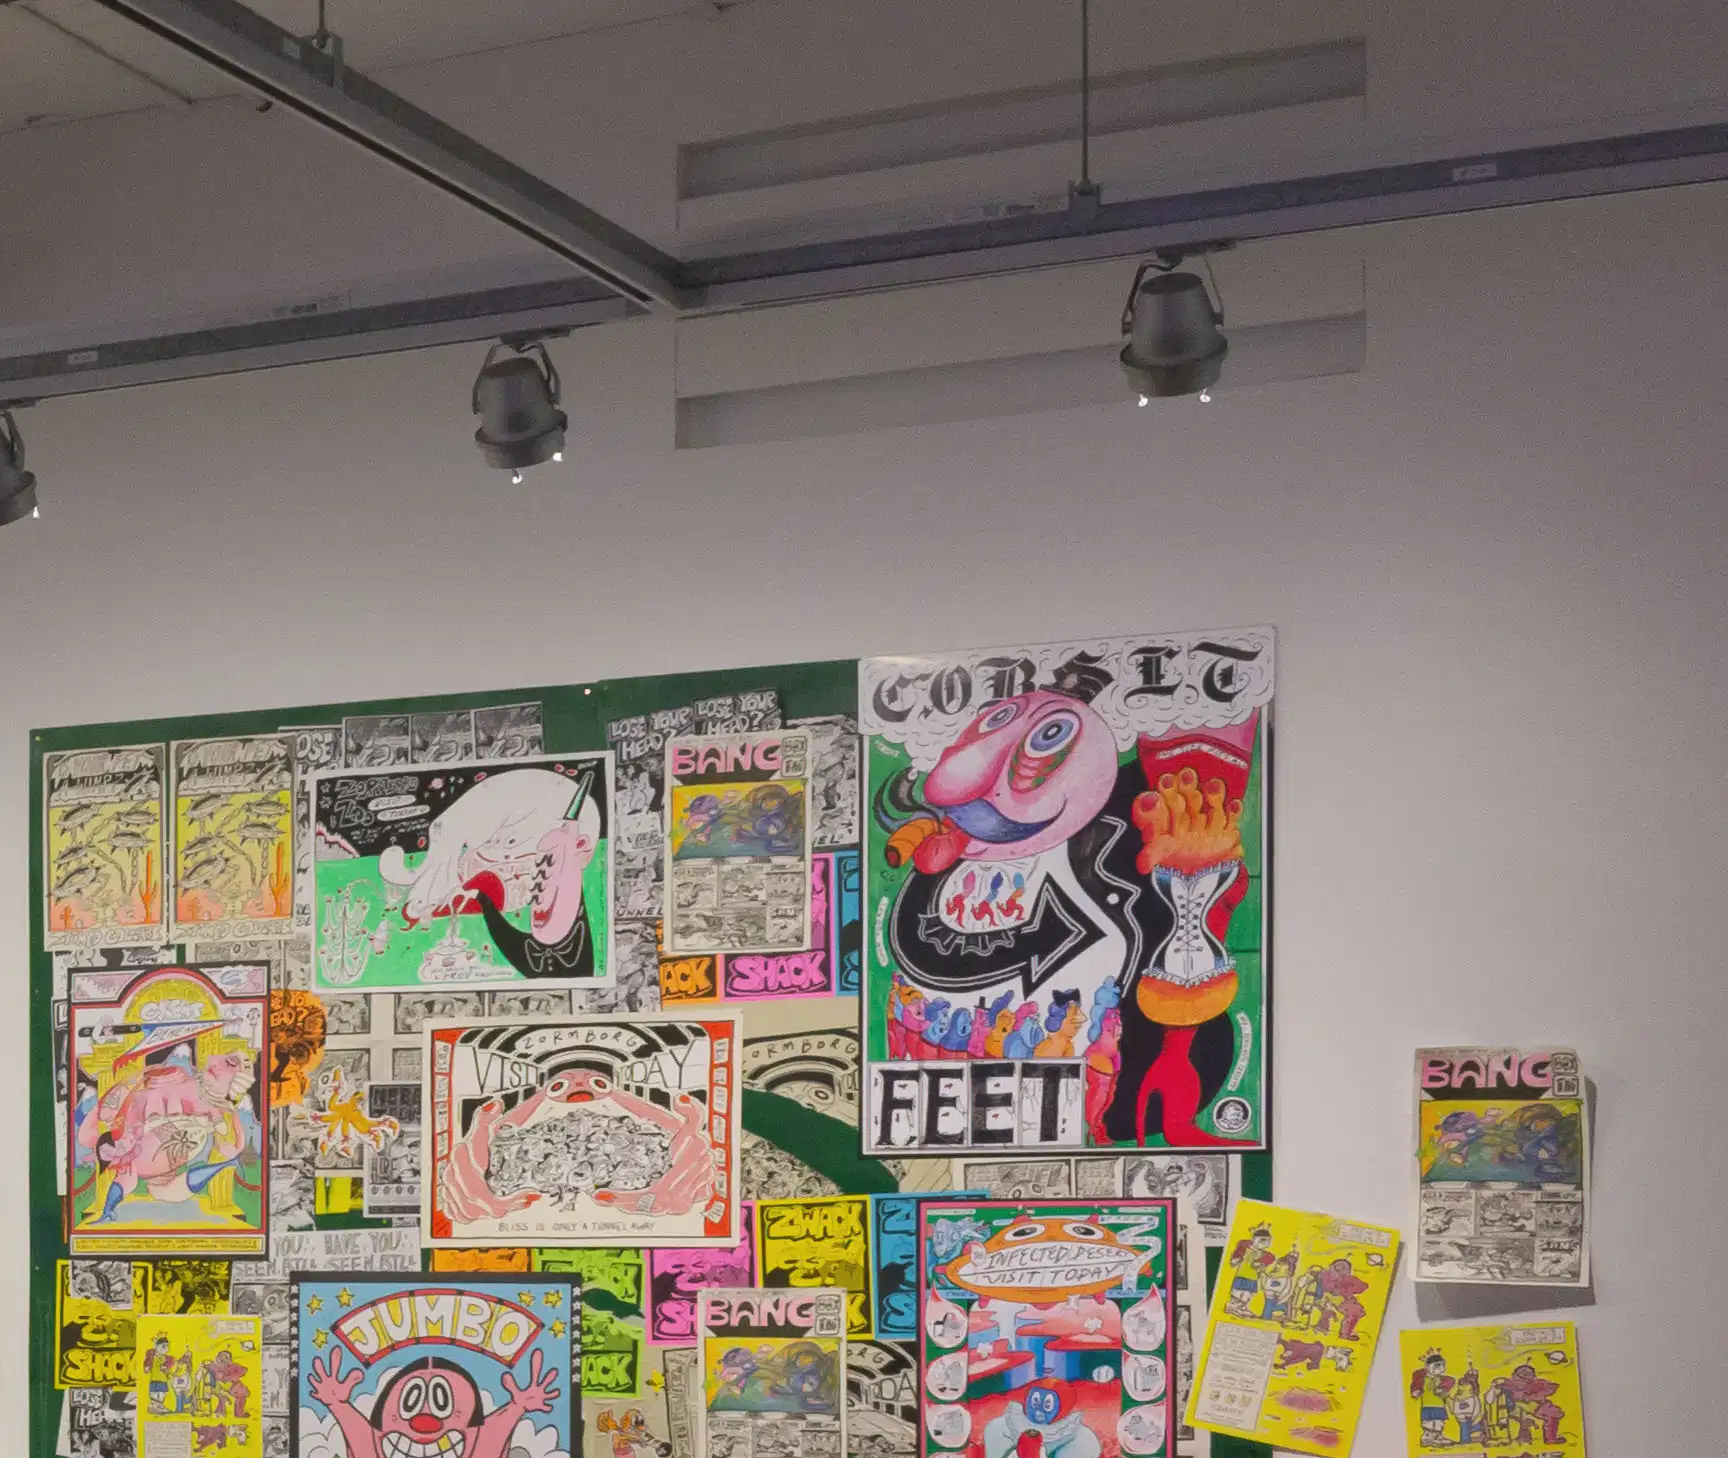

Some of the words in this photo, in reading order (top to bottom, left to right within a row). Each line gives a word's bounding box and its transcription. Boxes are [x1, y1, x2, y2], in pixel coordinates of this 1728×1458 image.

[697, 697, 735, 718] LOSE
[738, 689, 778, 711] YOUR
[610, 717, 647, 739] LOSE
[651, 706, 693, 729] YOUR
[703, 712, 763, 736] HEAD?
[620, 727, 677, 763] HEAD?
[671, 737, 782, 776] BANG
[725, 949, 828, 996] SHACK
[523, 1030, 638, 1049] ZORMBORG
[751, 1041, 857, 1059] ORMBORG
[472, 1046, 538, 1094] VISIT
[1420, 1052, 1553, 1090] BANG
[875, 1061, 1082, 1147] FEET
[497, 1221, 529, 1233] BLISS
[535, 1221, 545, 1232] IS
[552, 1221, 577, 1232] ONLY
[591, 1221, 627, 1232] TUNNEL
[766, 1203, 862, 1241] ZWACK
[981, 1270, 1040, 1285] VISIT
[1050, 1263, 1120, 1281] TODAY
[984, 1245, 1069, 1270] INFECTED
[348, 1295, 531, 1358] JUMBO
[705, 1297, 816, 1328] BANG
